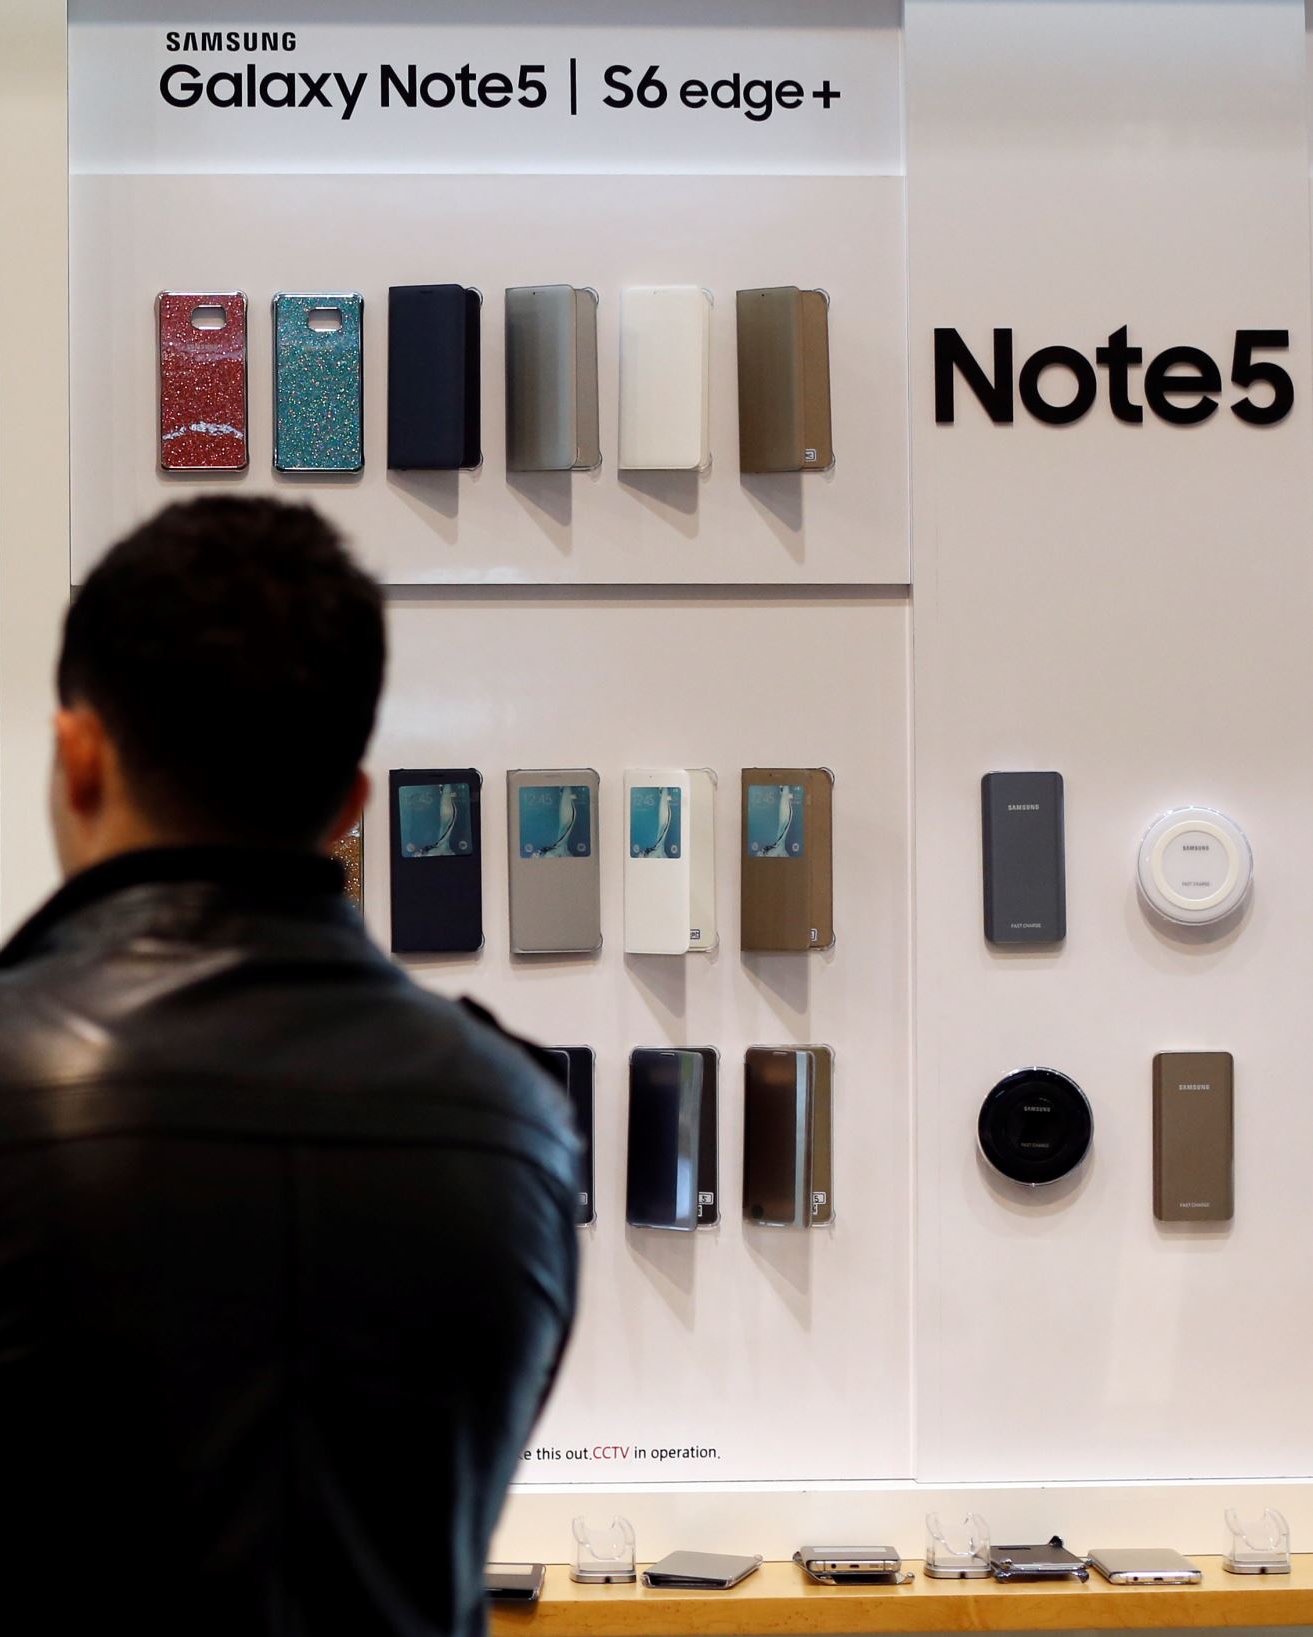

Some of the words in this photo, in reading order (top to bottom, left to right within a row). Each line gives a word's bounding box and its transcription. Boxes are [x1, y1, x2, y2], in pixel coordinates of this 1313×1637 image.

[166, 32, 296, 52] SAMSUNG
[160, 63, 368, 121] Galaxy
[381, 63, 547, 108] Note5
[602, 65, 668, 107] S6
[934, 325, 1295, 426] Note5
[536, 1447, 562, 1460] this
[634, 1446, 647, 1459] in
[650, 1445, 721, 1462] operation.
